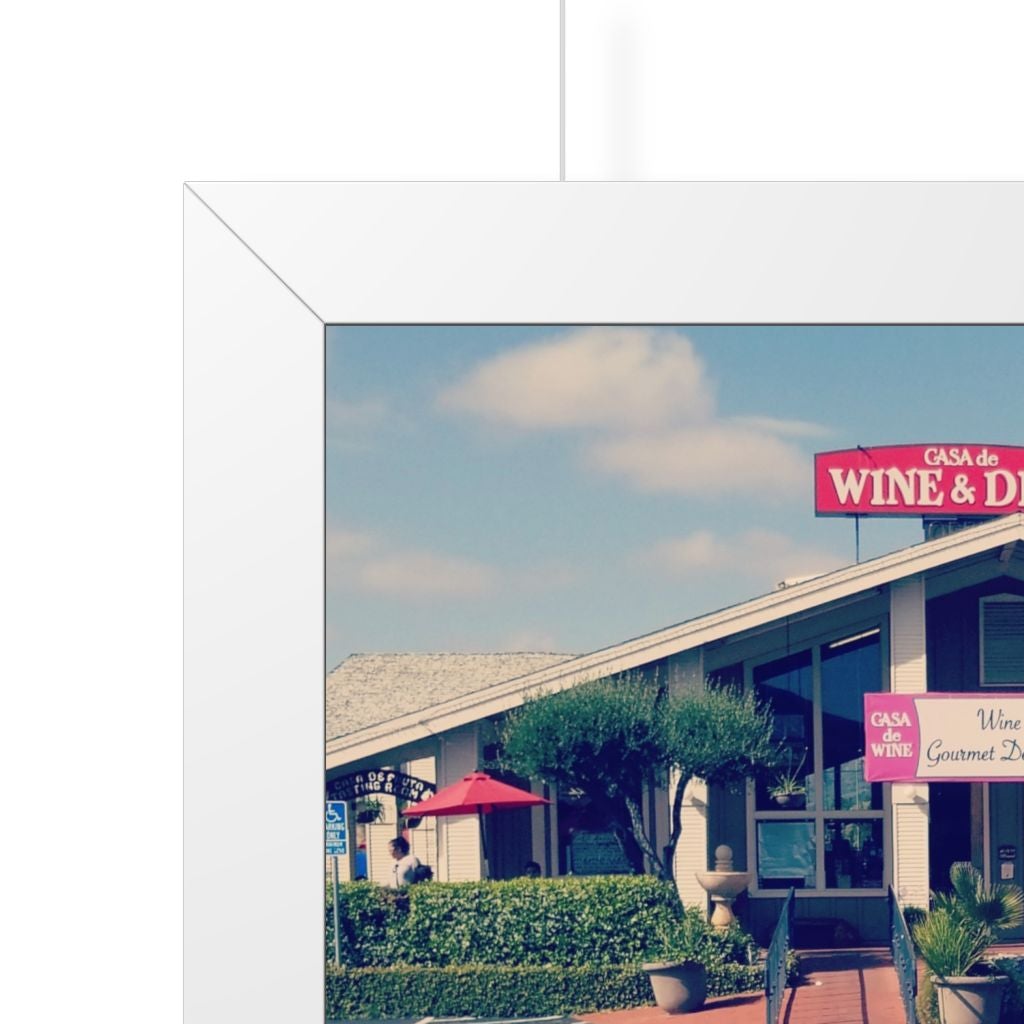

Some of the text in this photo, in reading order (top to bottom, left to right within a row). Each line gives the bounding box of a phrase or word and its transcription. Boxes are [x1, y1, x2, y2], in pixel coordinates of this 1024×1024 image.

[924, 448, 998, 466] CASA de
[828, 467, 944, 506] WINE
[950, 474, 976, 504] &
[871, 712, 912, 727] CASA
[976, 708, 1021, 731] Wine
[882, 728, 902, 742] de
[871, 743, 913, 757] WINE
[926, 739, 995, 767] Gourmet
